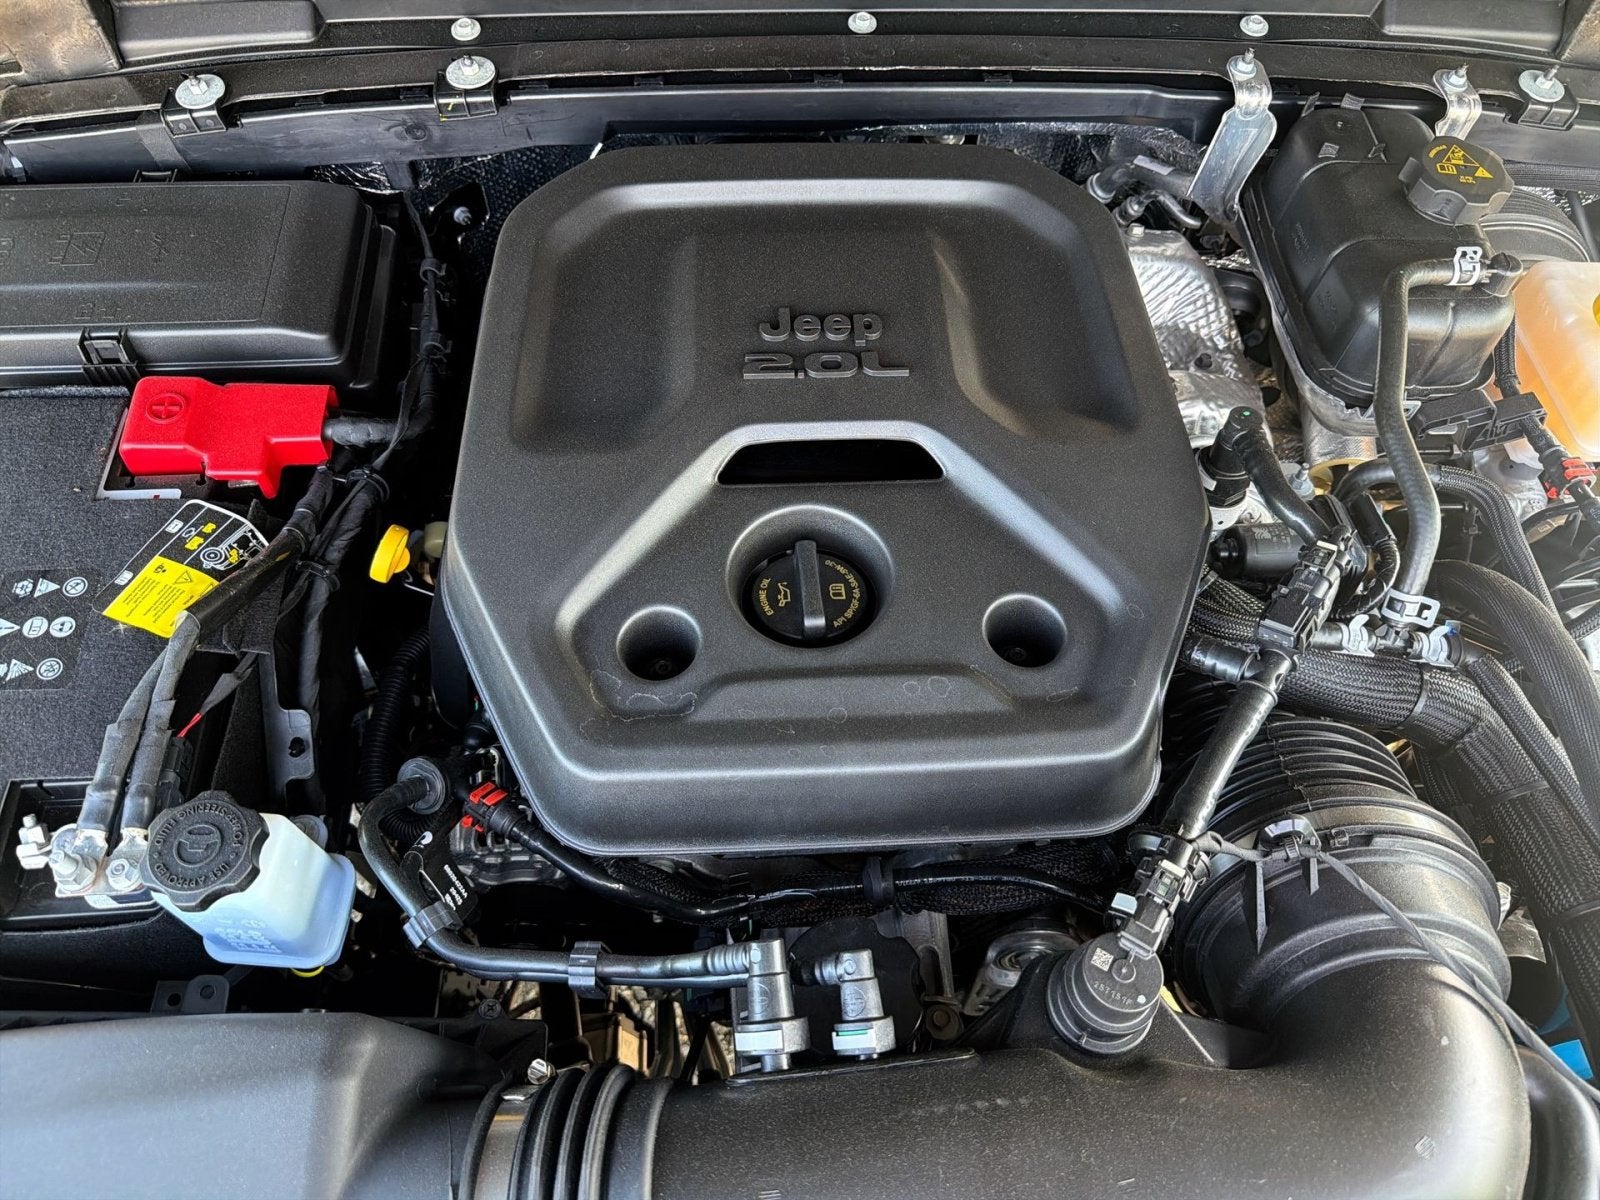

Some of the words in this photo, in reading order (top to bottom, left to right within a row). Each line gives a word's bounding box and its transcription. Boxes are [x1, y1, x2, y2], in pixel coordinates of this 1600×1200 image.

[759, 306, 883, 347] Jeep
[743, 351, 910, 380] 2.0L
[760, 577, 772, 589] OIL
[758, 589, 775, 617] ENGINE
[832, 616, 848, 629] API
[176, 803, 228, 819] STEERING
[154, 818, 177, 846] FLUID
[224, 812, 244, 847] POWER
[154, 863, 206, 888] APPROVED
[208, 862, 231, 881] USE
